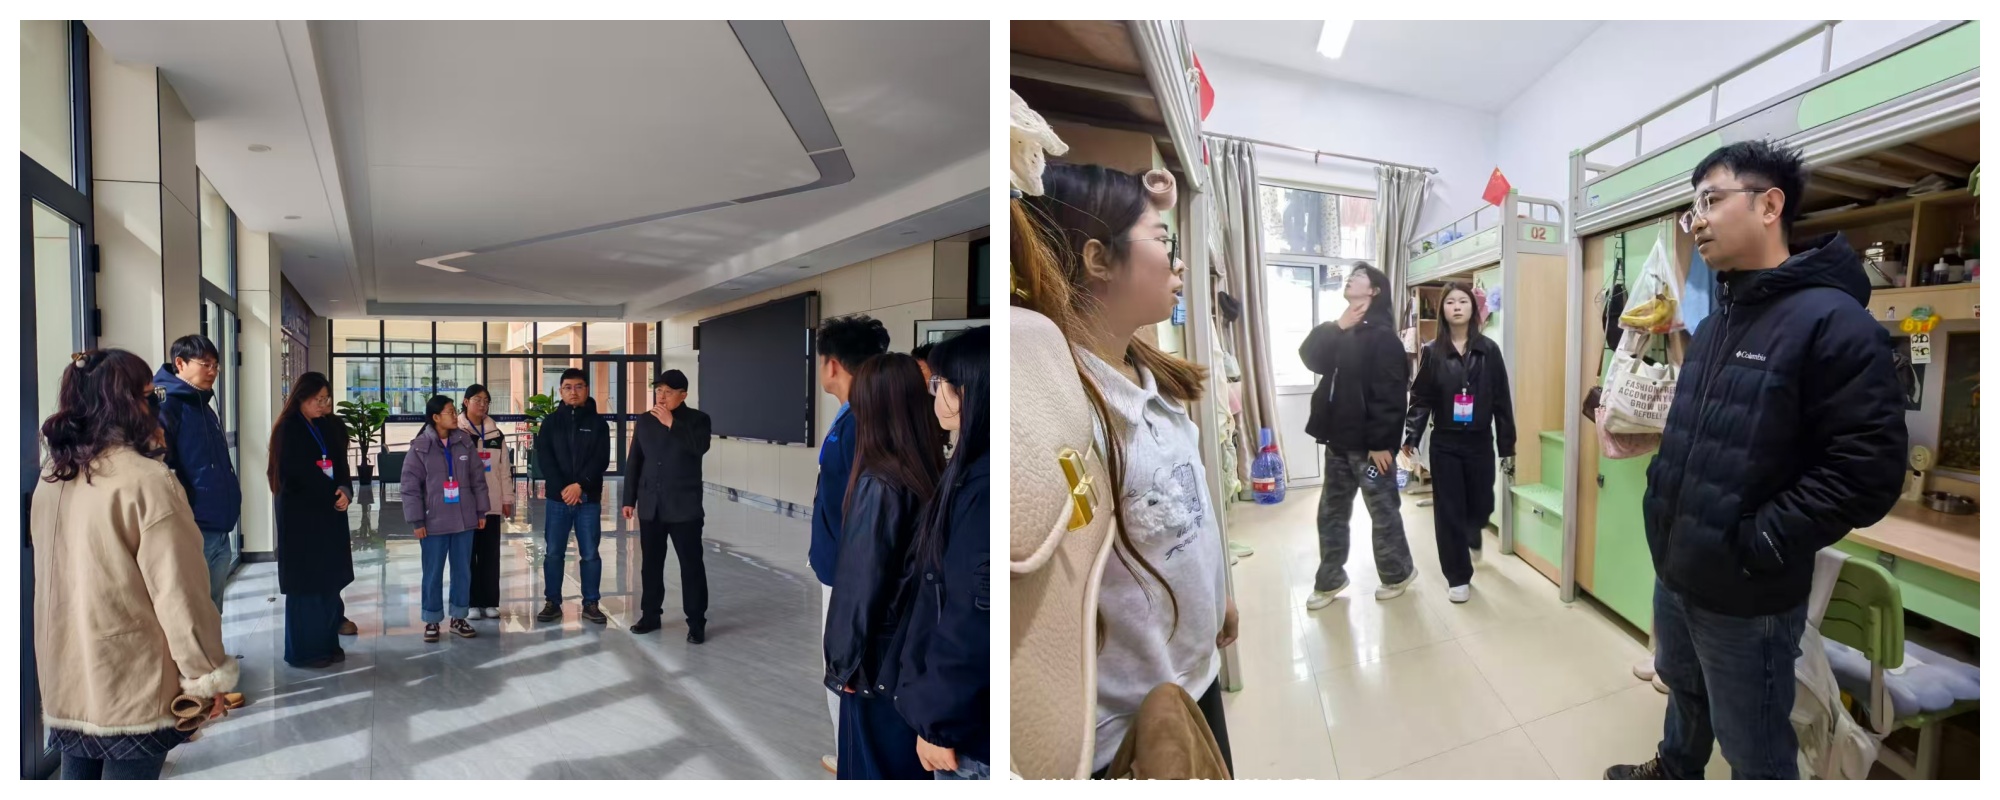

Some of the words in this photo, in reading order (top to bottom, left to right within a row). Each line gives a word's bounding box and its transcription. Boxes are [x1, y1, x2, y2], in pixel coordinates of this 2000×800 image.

[1531, 226, 1546, 240] 02
[1618, 387, 1668, 402] ACCOMPANY
[1630, 399, 1655, 411] GROW
[1657, 403, 1668, 412] UP
